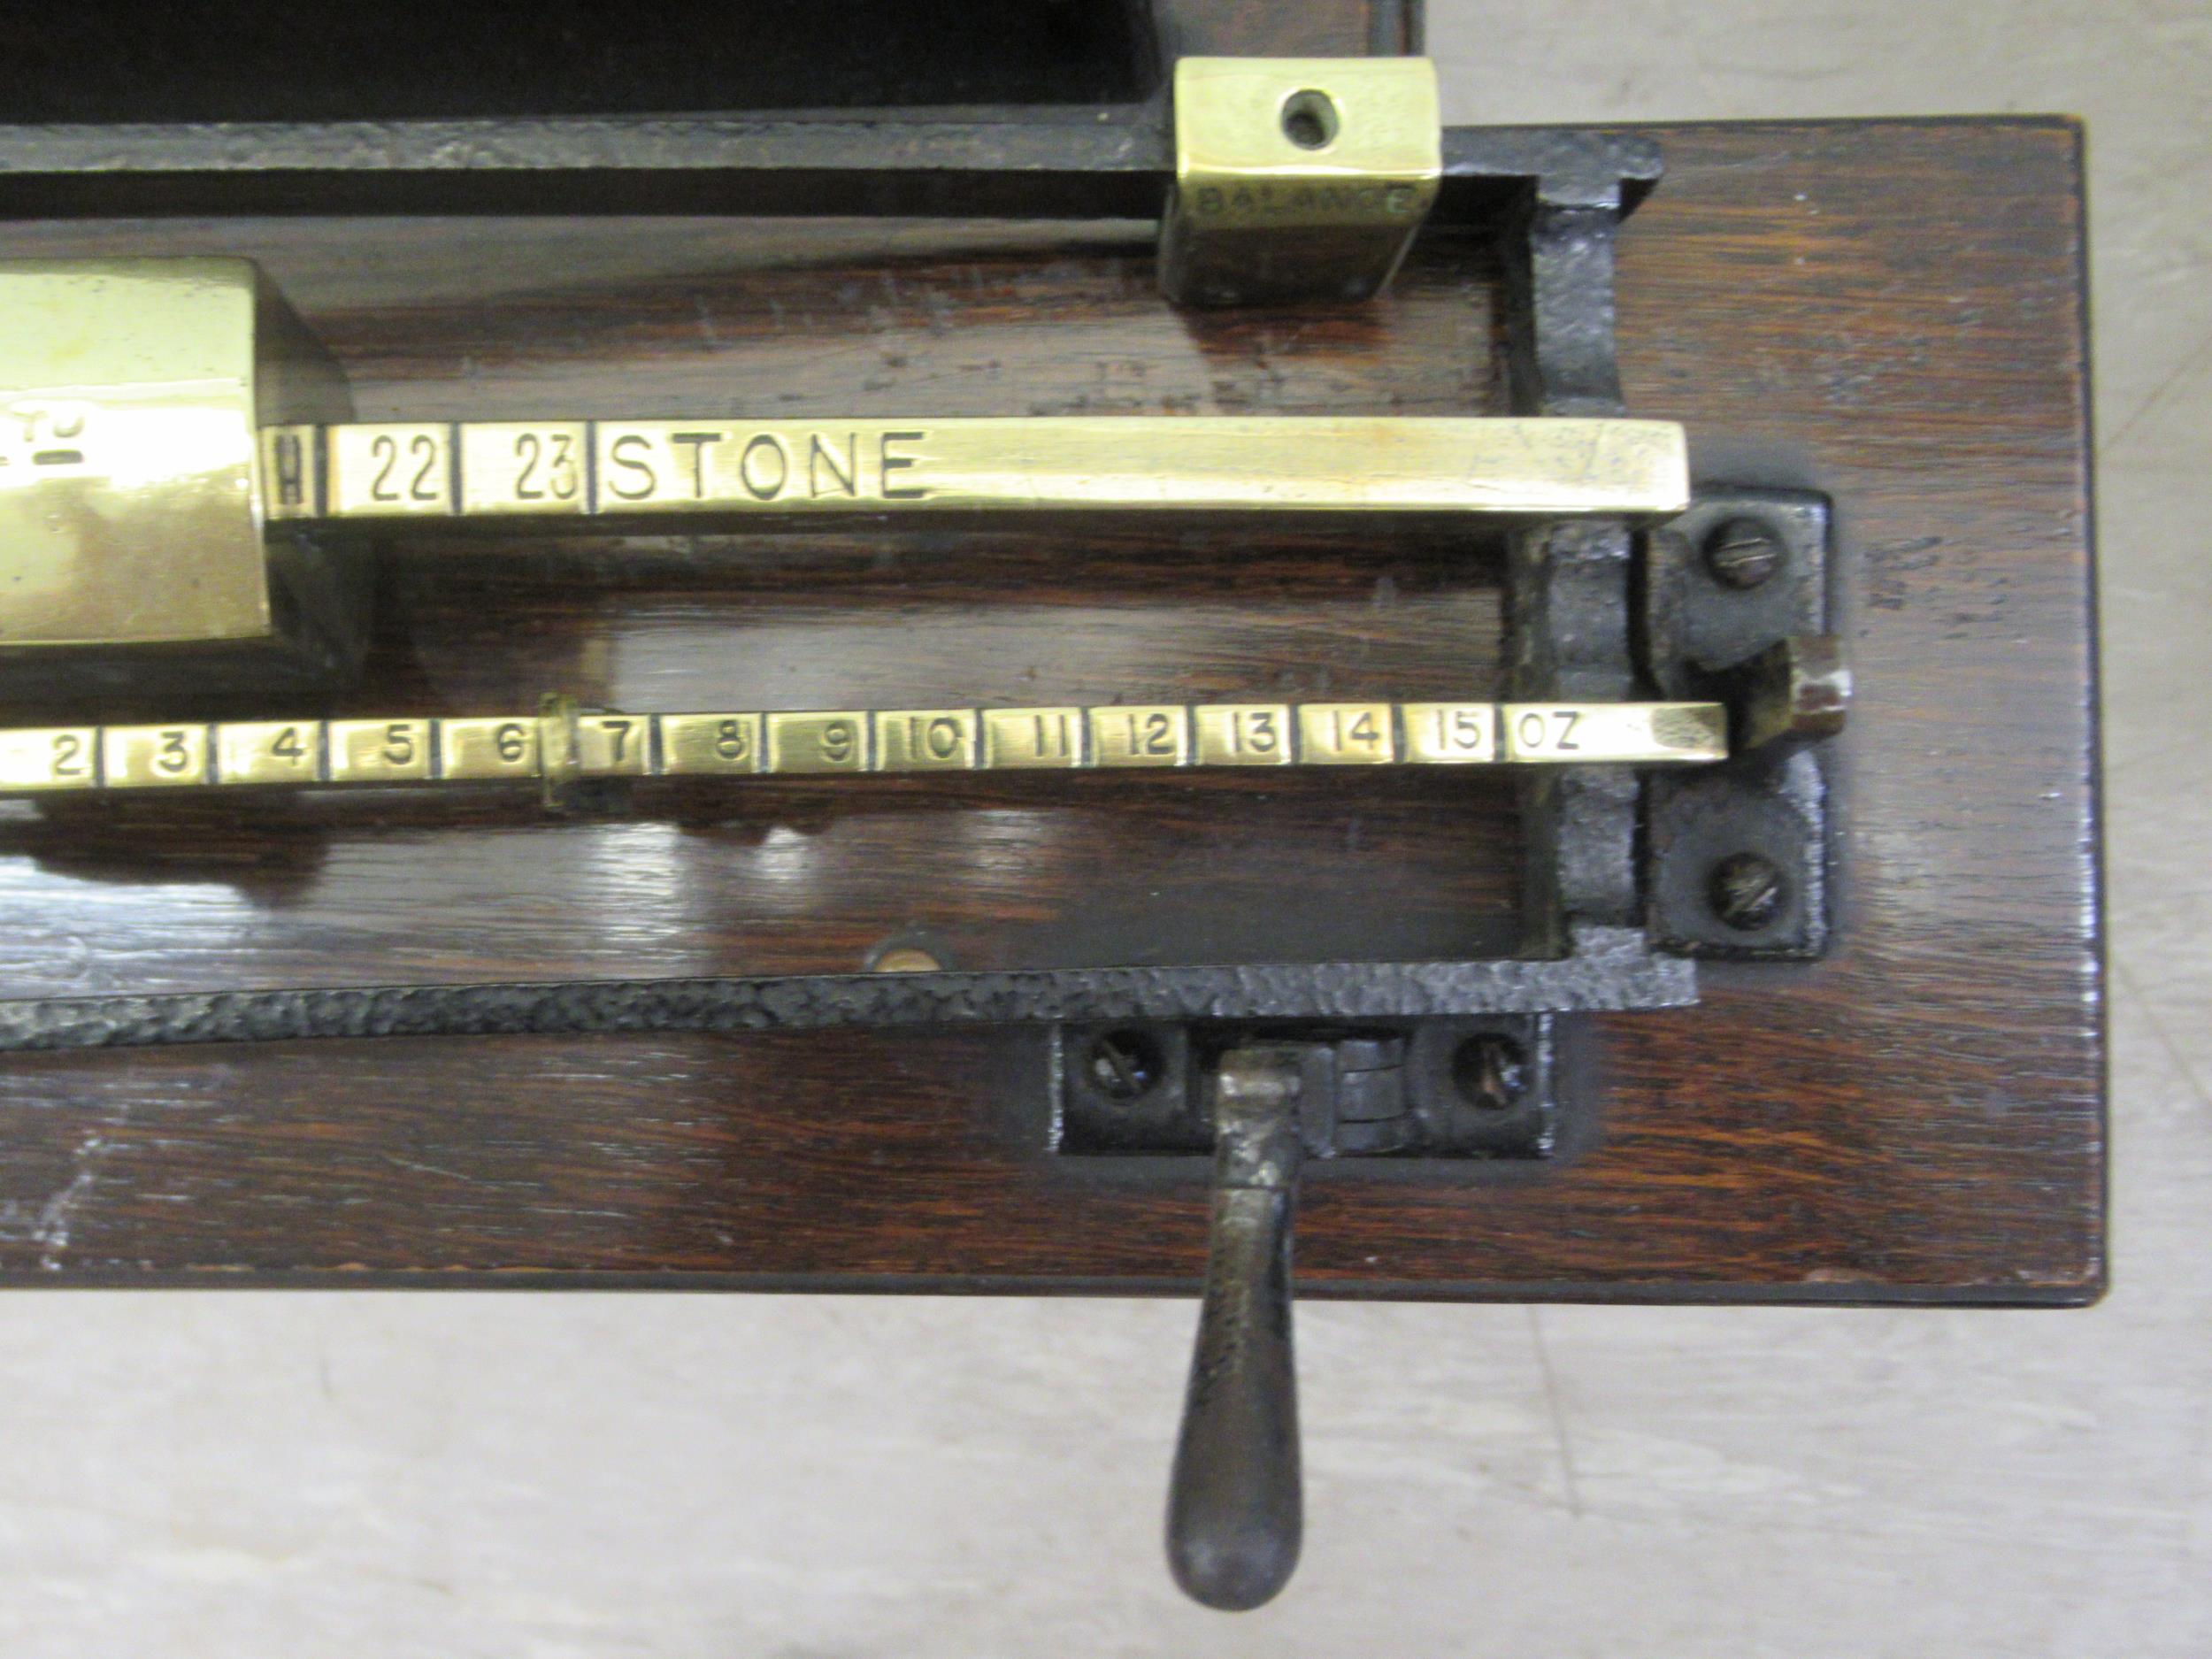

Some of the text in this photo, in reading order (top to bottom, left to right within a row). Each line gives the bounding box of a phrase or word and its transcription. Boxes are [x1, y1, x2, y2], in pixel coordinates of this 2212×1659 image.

[371, 434, 439, 502] 22
[516, 433, 579, 501] 23
[608, 431, 926, 501] STONE
[53, 710, 1580, 776] 2 3 4 5 6 7 8 9 10 11 12 13 14 15 OZ
